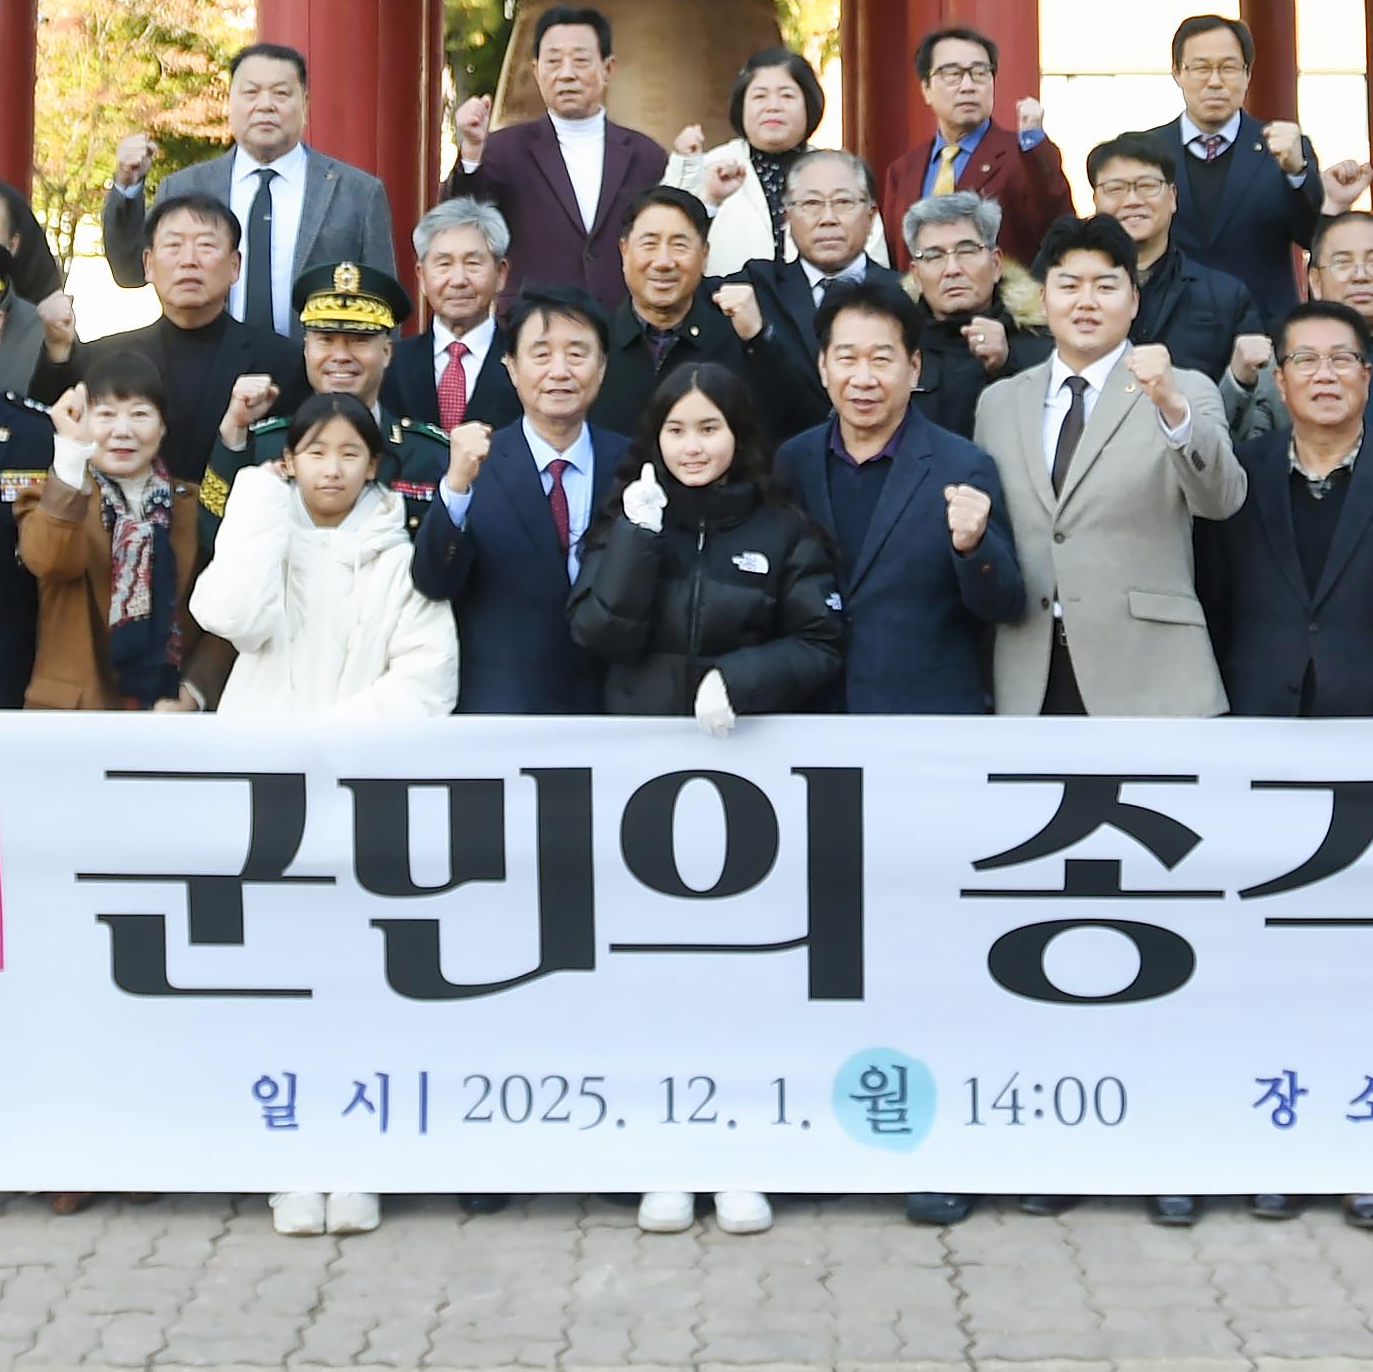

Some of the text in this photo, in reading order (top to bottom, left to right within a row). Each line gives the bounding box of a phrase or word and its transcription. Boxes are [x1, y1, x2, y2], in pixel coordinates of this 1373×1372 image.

[73, 766, 865, 1003] 군민의
[251, 1064, 1128, 1134] 일 시 2025. 12. 1. 월 14:00
[1252, 1068, 1310, 1130] 장
